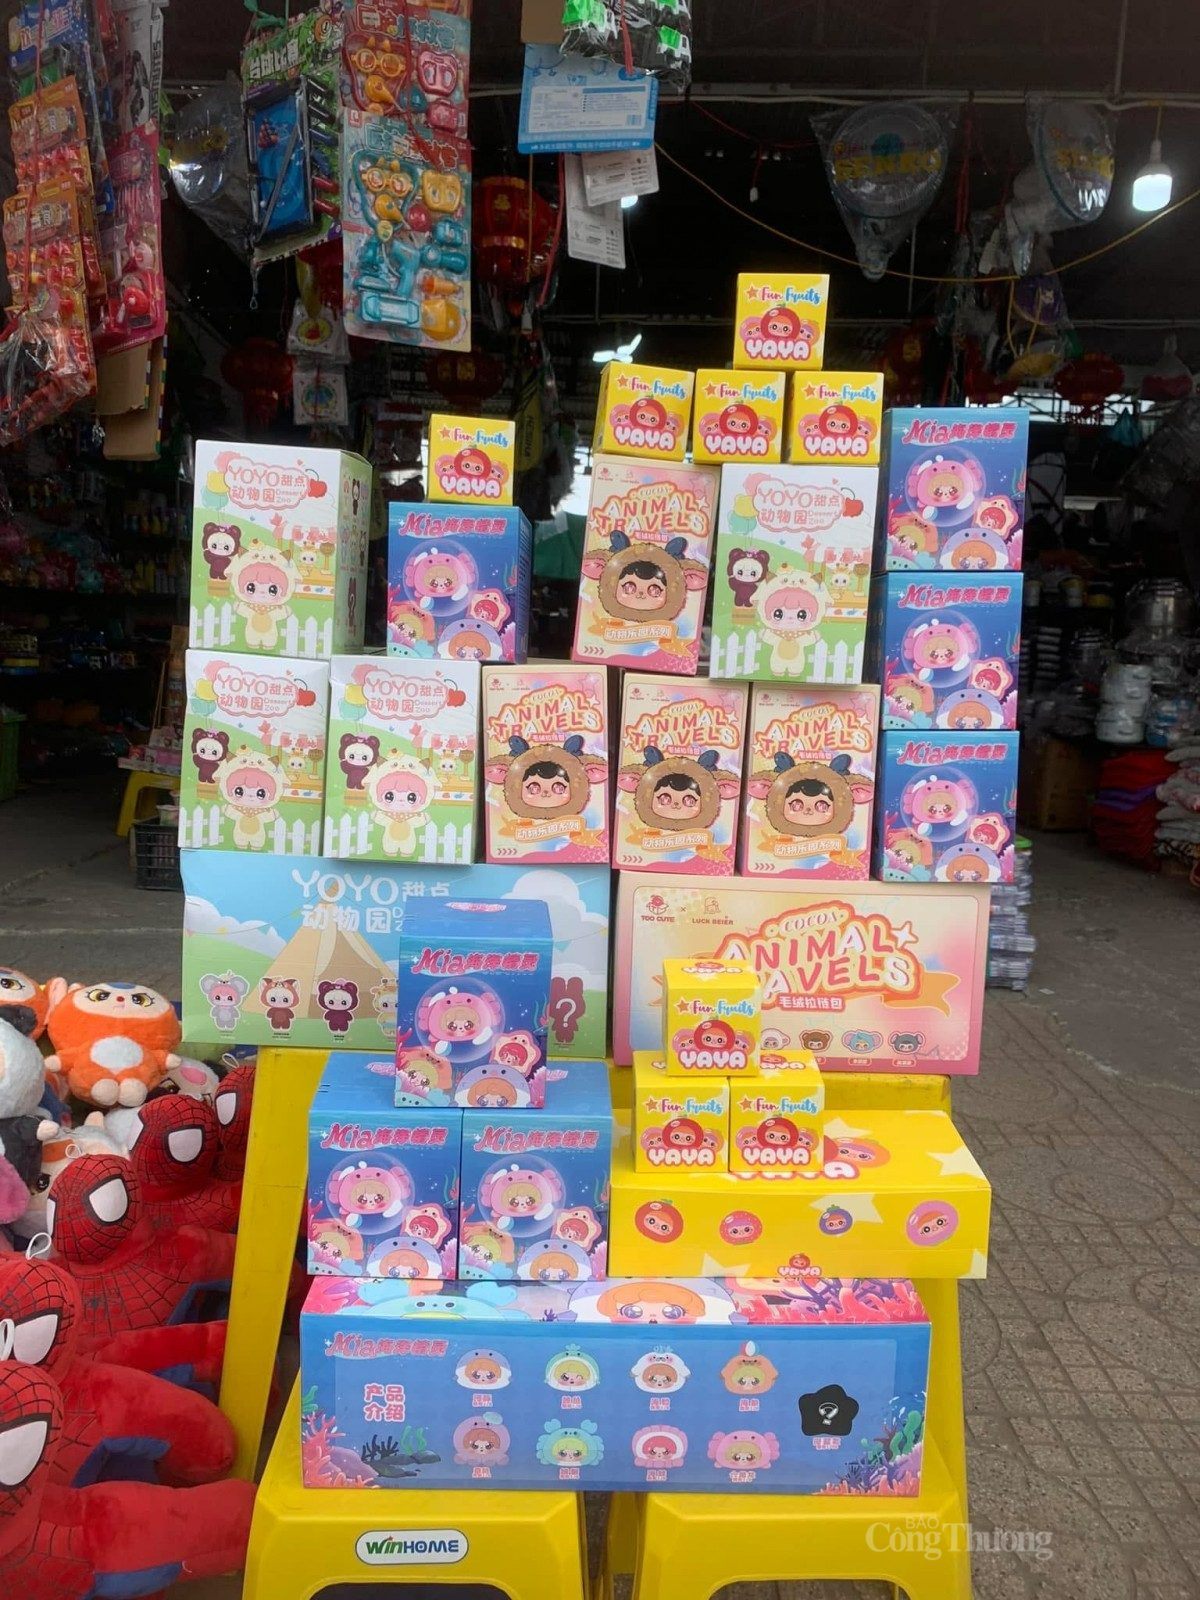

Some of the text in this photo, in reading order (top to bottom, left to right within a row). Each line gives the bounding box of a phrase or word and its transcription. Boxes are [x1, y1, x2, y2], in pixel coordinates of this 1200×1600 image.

[760, 287, 821, 304] Fun Fruits
[745, 338, 811, 360] YAYA
[631, 377, 686, 399] Fun Fruits
[719, 383, 777, 401] Fun Fruits
[818, 384, 877, 401] Fun Fruits
[453, 428, 509, 447] Fun Fruits
[613, 425, 676, 451] YAYA
[704, 434, 769, 455] YAYA
[803, 435, 869, 456] YAYA
[228, 465, 306, 487] YOYO 甜点
[440, 474, 502, 498] YAYA
[231, 486, 276, 503] 动物园
[757, 487, 841, 508] YOYO 甜点
[606, 496, 698, 518] ANIMAL
[761, 508, 808, 525] 动物园
[599, 513, 705, 534] TRAVELS
[217, 674, 294, 697] YOYO 甜点
[366, 677, 444, 699] YOYO 甜点
[219, 695, 263, 711] 动物园
[370, 698, 414, 714] 动物园
[501, 695, 589, 724] ANIMAL
[494, 712, 598, 736] TRAVELS
[639, 713, 726, 734] ANIMAL
[769, 716, 858, 739] ANIMAL
[633, 728, 736, 747] TRAVELS
[762, 732, 868, 752] TRAVELS
[291, 869, 399, 906] YOYO
[301, 903, 392, 934] 动物园
[783, 911, 840, 933] COCOA
[721, 923, 895, 972] ANIMAL
[760, 955, 911, 1001] AVELS
[691, 998, 755, 1017] Fun Fruits
[678, 1049, 748, 1070] YAYA
[660, 1097, 724, 1115] Fun Fruits
[755, 1097, 819, 1115] Fun Fruits
[646, 1146, 716, 1167] YAYA
[741, 1146, 811, 1167] YAYA
[777, 1265, 822, 1278] YAYA
[364, 1383, 405, 1403] 产品
[364, 1403, 405, 1423] 介绍
